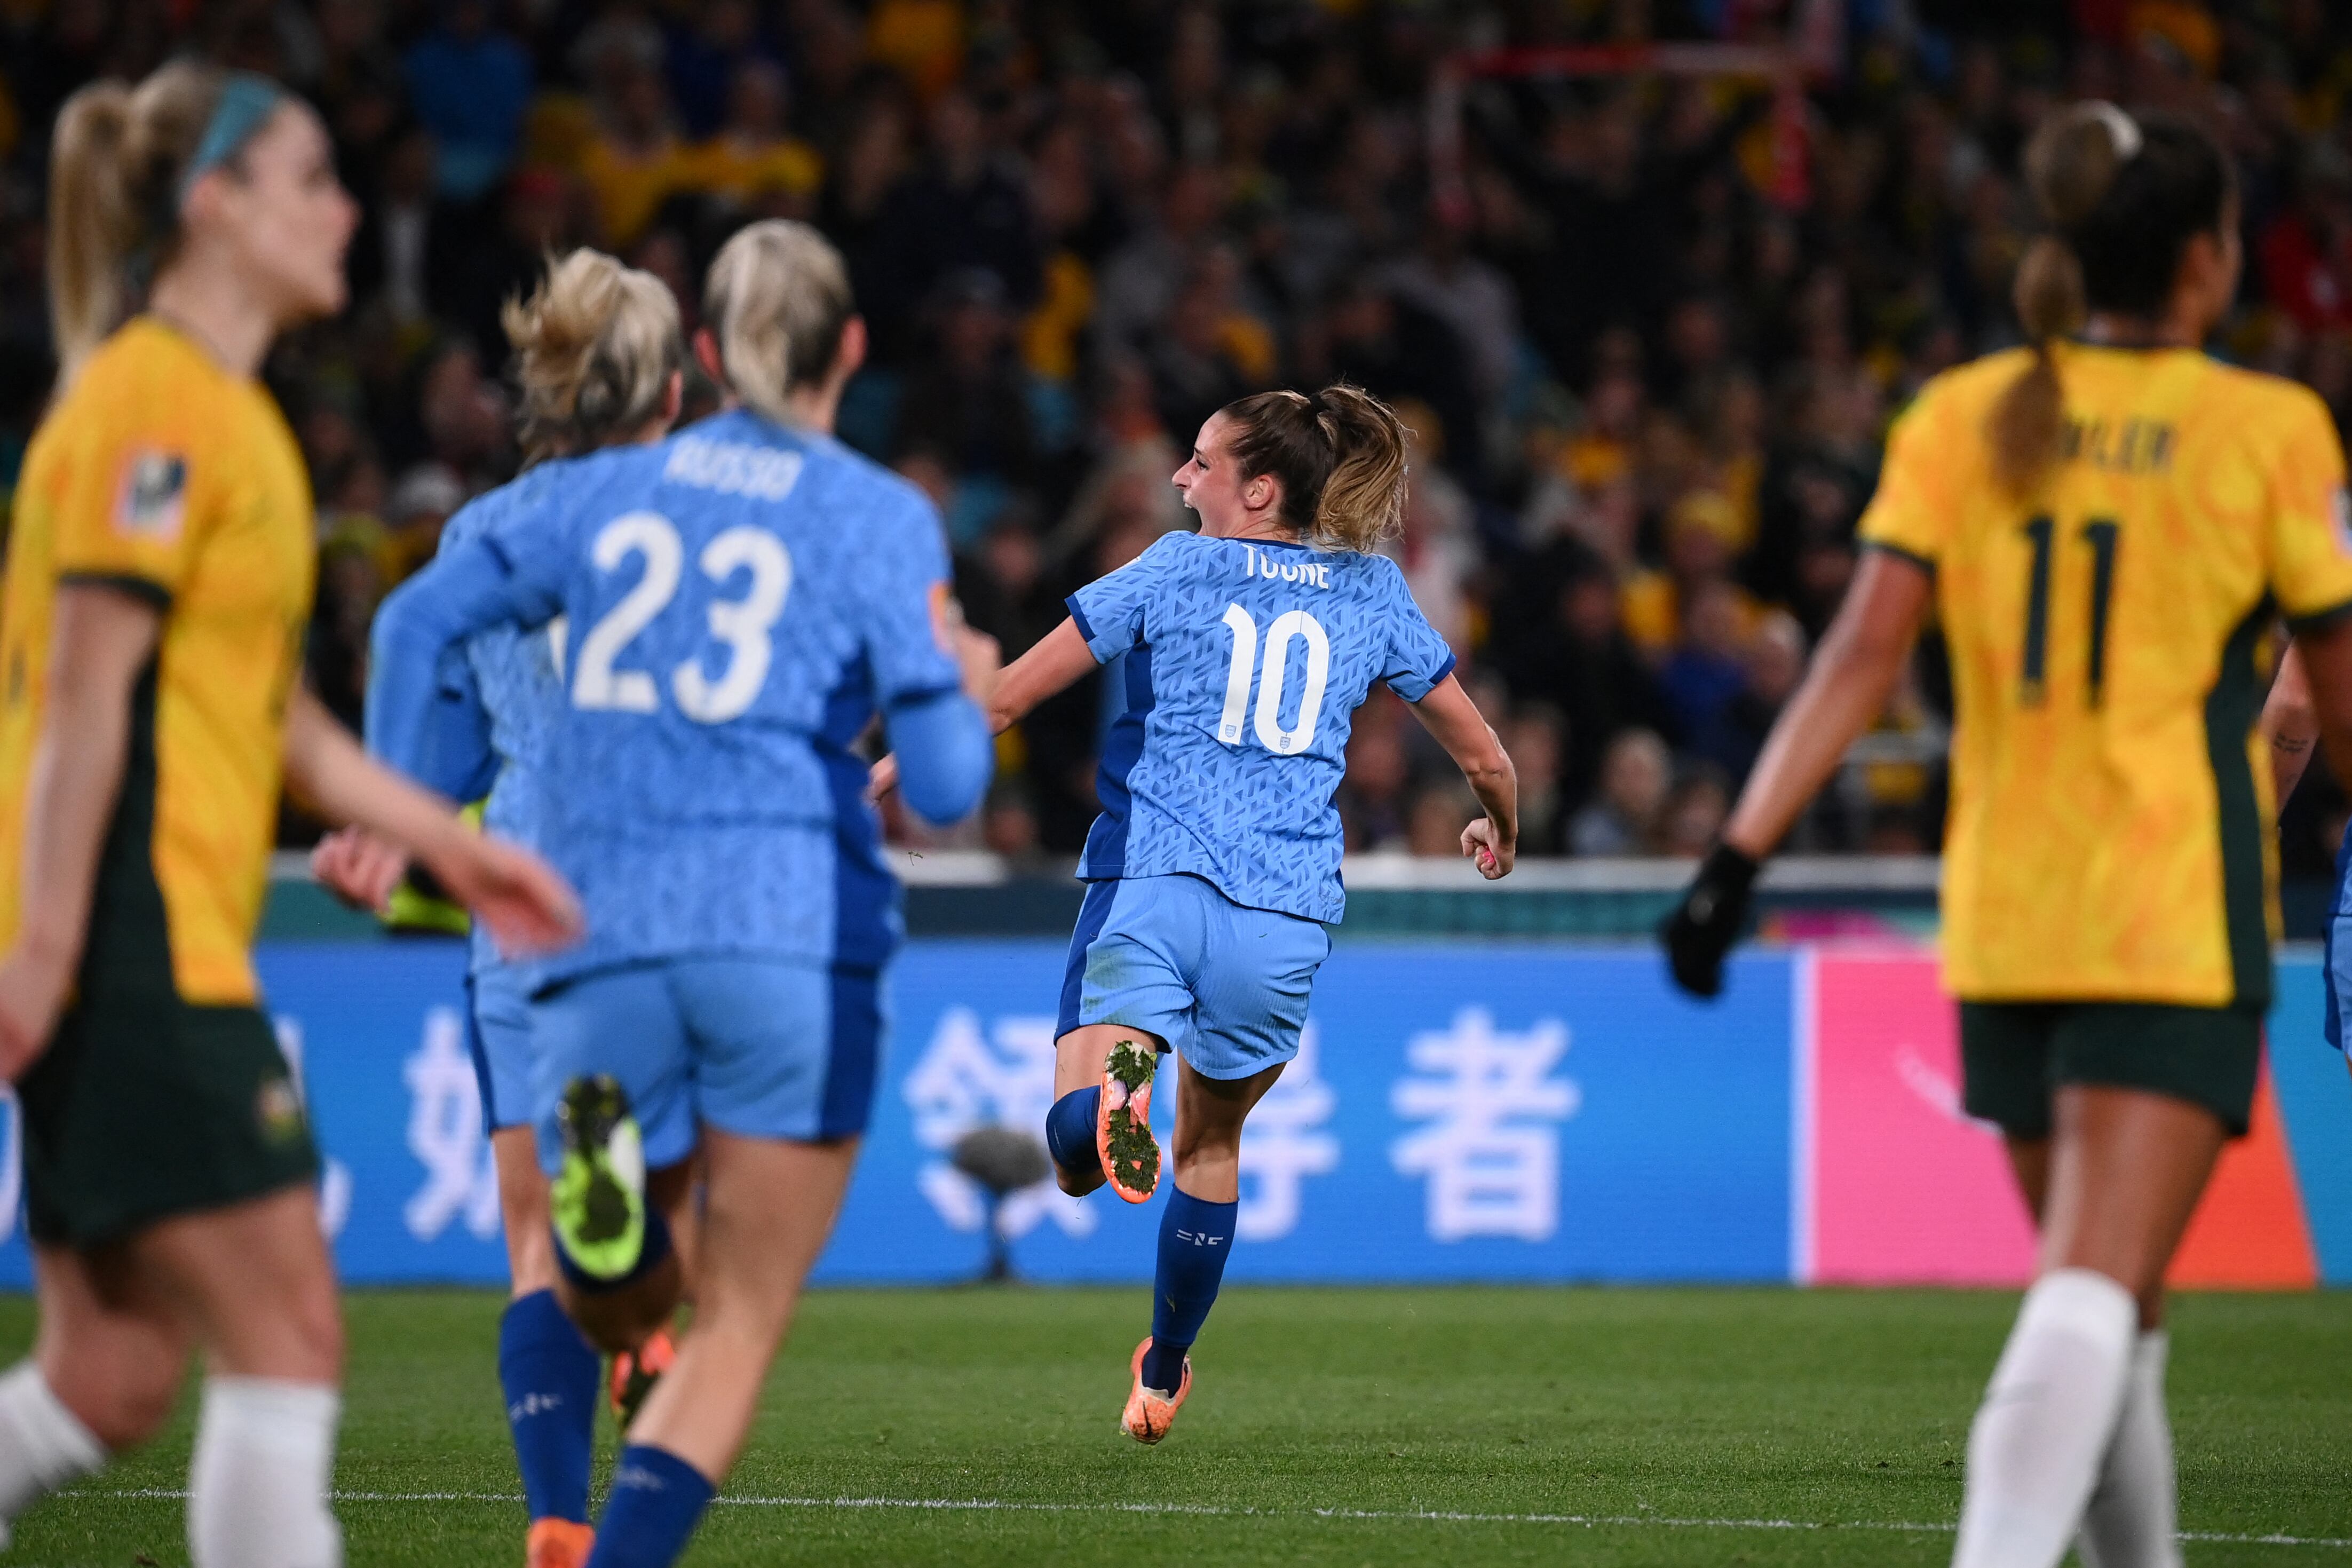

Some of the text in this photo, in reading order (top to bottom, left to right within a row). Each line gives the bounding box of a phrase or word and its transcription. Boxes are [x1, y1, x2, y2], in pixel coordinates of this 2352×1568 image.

[572, 511, 793, 725] 23
[1217, 603, 1329, 755] 10
[2021, 516, 2119, 709] 11
